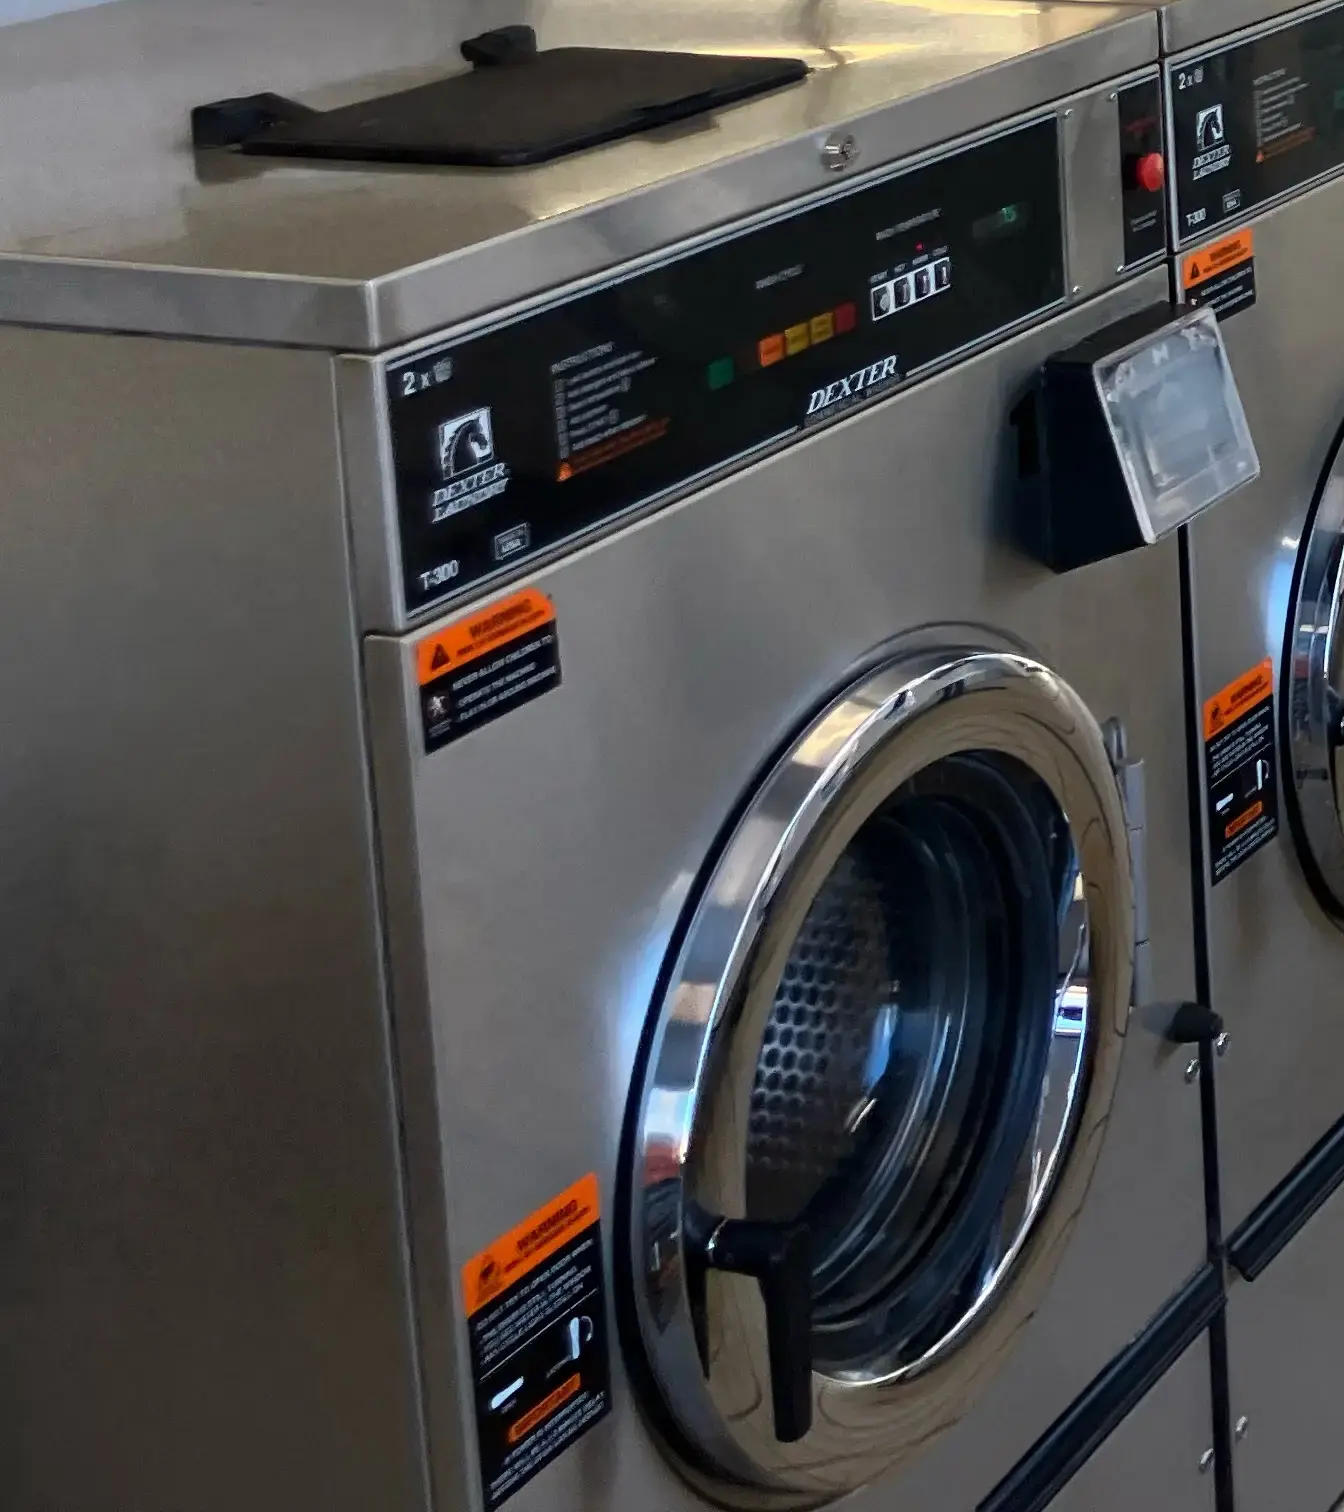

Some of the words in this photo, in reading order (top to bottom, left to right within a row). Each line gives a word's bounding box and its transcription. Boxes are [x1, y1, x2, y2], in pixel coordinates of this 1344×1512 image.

[1178, 73, 1187, 90] 2
[402, 371, 417, 396] 2
[806, 355, 900, 415] DEXTER
[433, 463, 507, 507] DEXTER
[420, 559, 460, 591] T-300
